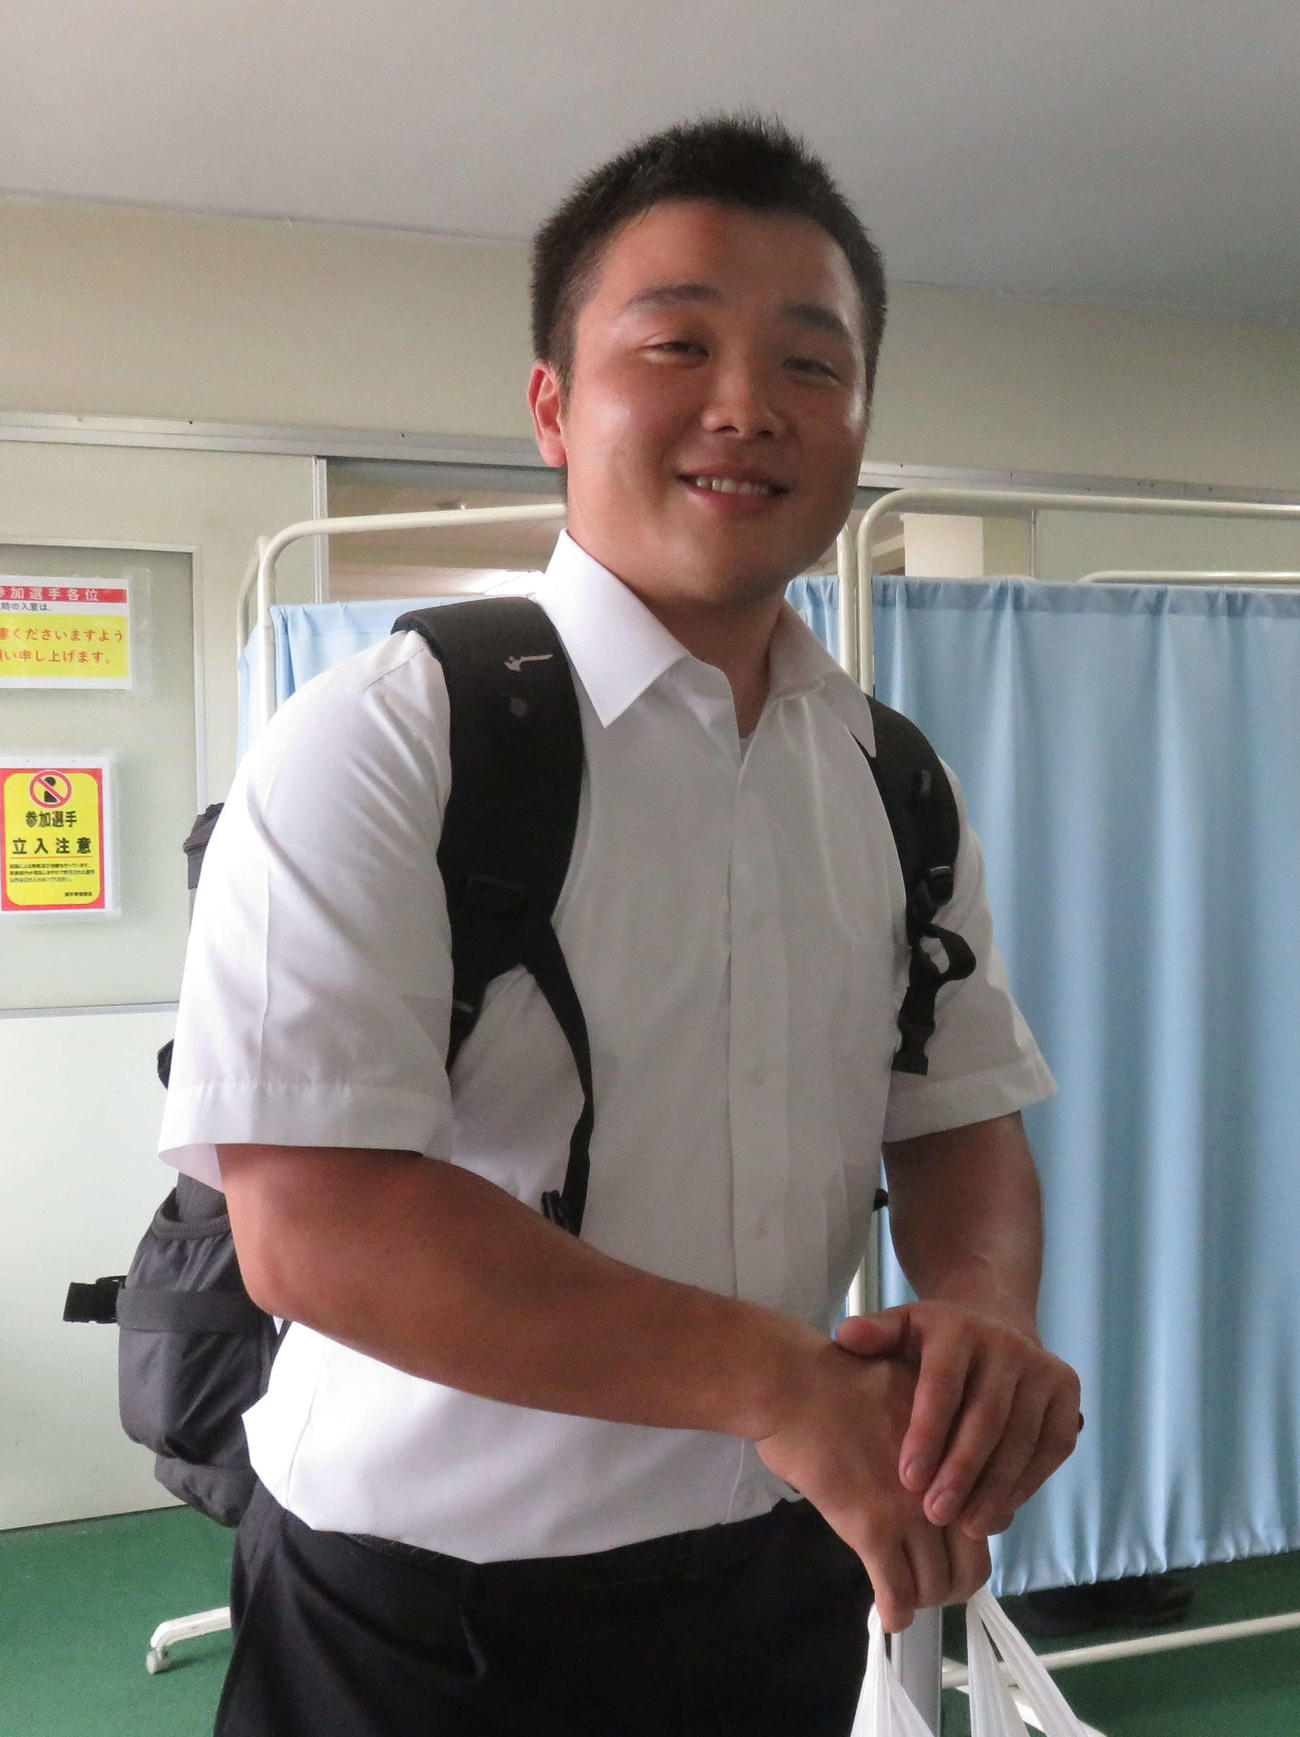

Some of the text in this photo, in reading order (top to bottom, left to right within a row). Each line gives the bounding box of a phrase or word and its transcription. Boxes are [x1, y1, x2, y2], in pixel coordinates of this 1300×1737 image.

[0, 649, 110, 664] い申し上げます。
[25, 810, 77, 828] 参加選手
[12, 837, 92, 855] 立入注意
